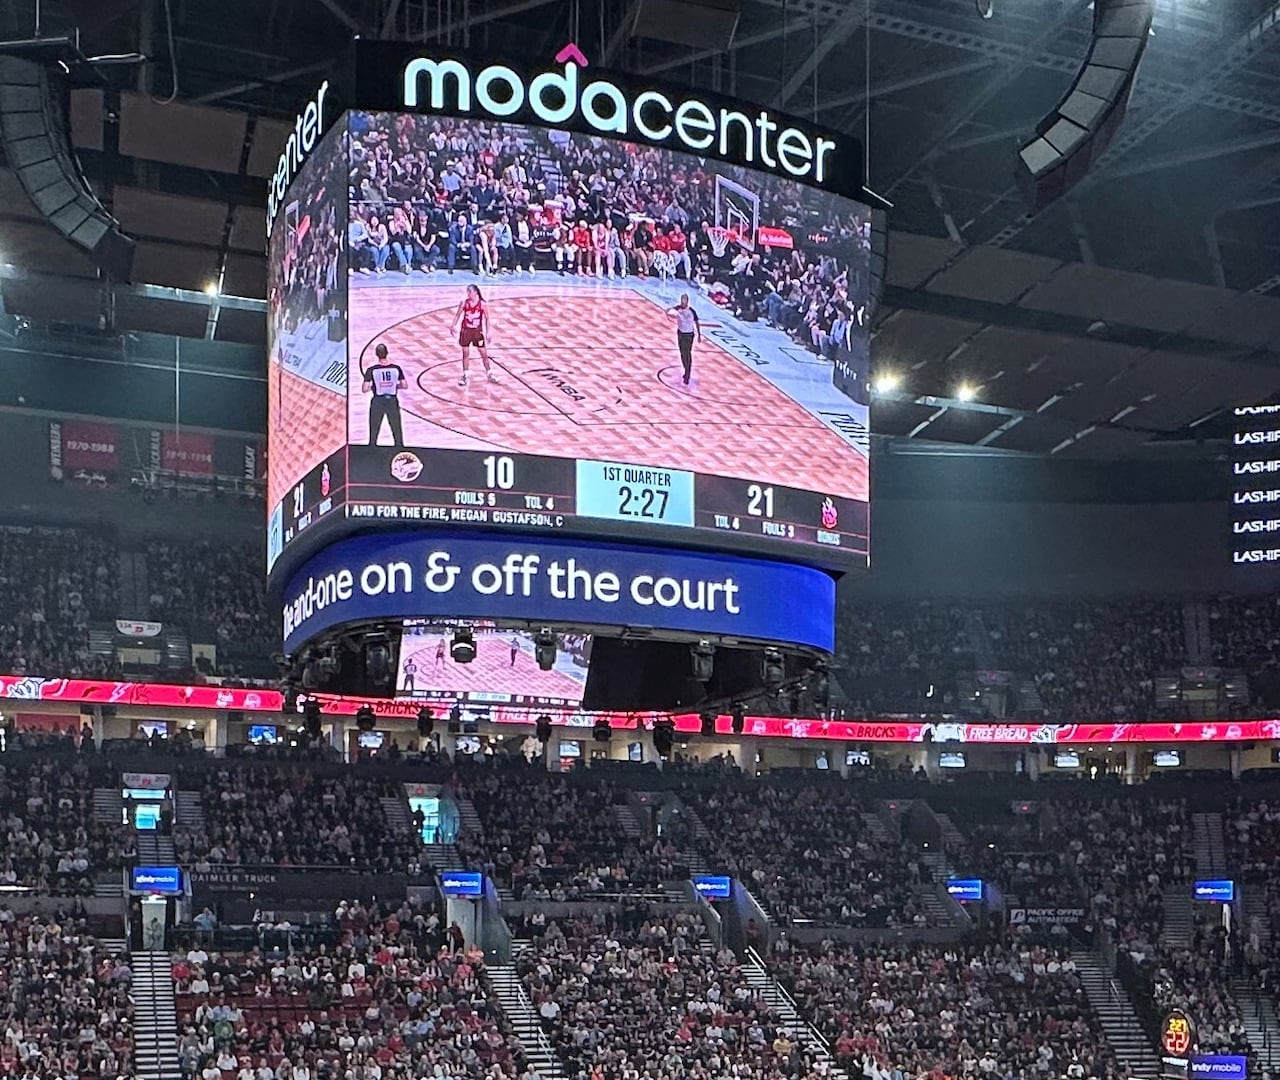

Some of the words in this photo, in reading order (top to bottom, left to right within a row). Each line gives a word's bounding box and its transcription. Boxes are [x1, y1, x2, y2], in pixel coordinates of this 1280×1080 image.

[484, 456, 515, 489] 10
[603, 467, 622, 482] 1ST
[625, 468, 671, 487] QUARTER
[455, 491, 484, 506] FOULS
[525, 495, 542, 509] TOL
[618, 487, 669, 519] 2:27
[747, 485, 773, 517] 21
[352, 505, 374, 517] AND
[377, 506, 398, 518] FOR
[400, 507, 420, 519] THE
[423, 508, 448, 521] FIRE,
[451, 510, 487, 522] MEGAN
[493, 511, 554, 527] GUSTAFSON,
[714, 515, 730, 529] TOL
[294, 570, 353, 627] and-one
[361, 561, 412, 595] on
[425, 552, 461, 592] &
[472, 553, 540, 597] off
[546, 557, 620, 602] the
[630, 573, 740, 615] court
[857, 726, 895, 738] BRICKS
[970, 728, 993, 740] FREE
[995, 728, 1028, 740] BREAD
[191, 874, 238, 883] DAIMLER
[245, 874, 277, 883] TRUCK
[1166, 1032, 1190, 1051] 22
[1213, 1062, 1242, 1073] mobile
